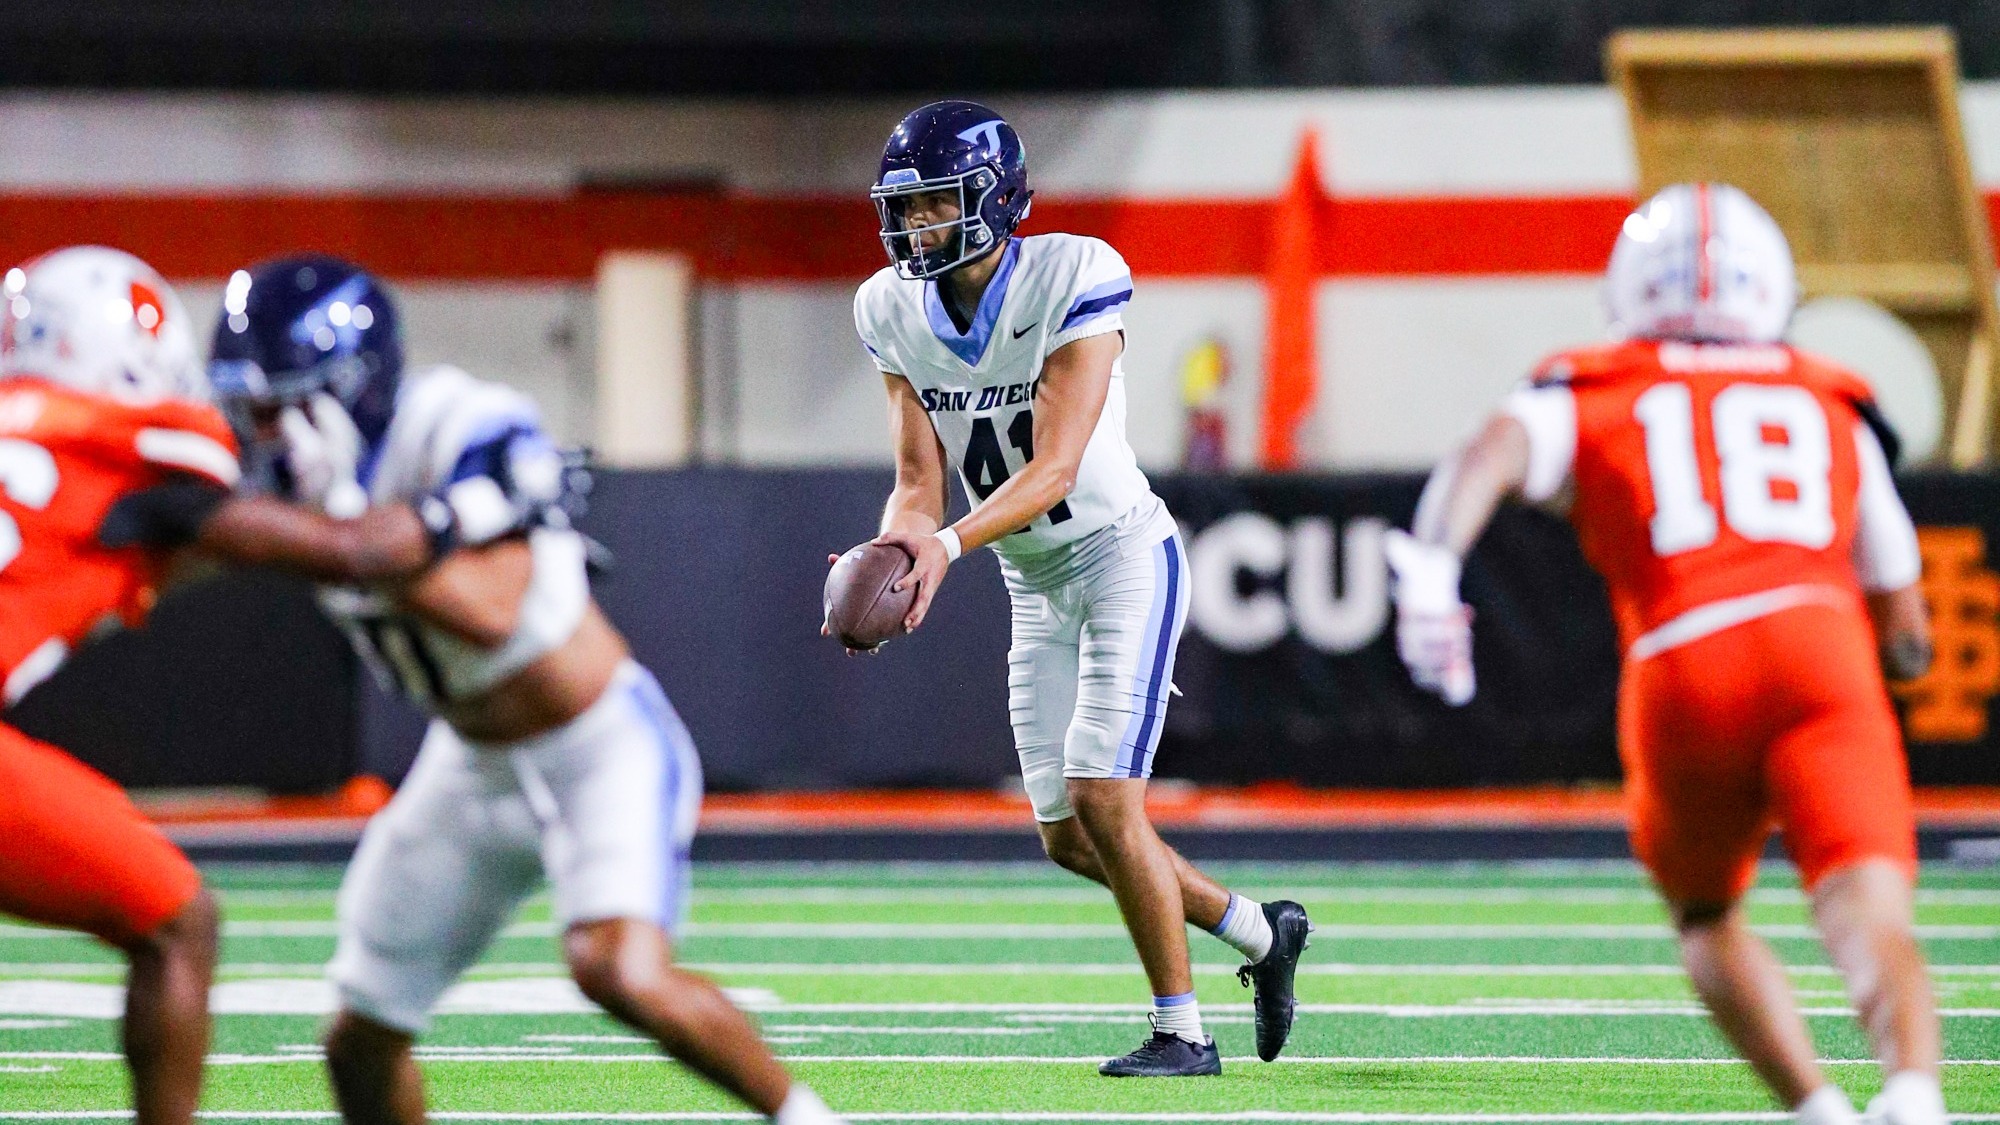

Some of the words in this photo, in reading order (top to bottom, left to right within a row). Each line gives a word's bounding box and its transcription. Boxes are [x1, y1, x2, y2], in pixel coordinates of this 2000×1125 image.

[921, 388, 972, 411] SAN
[963, 410, 1073, 534] 41
[1633, 381, 1837, 558] 18
[1182, 512, 1392, 653] CU
